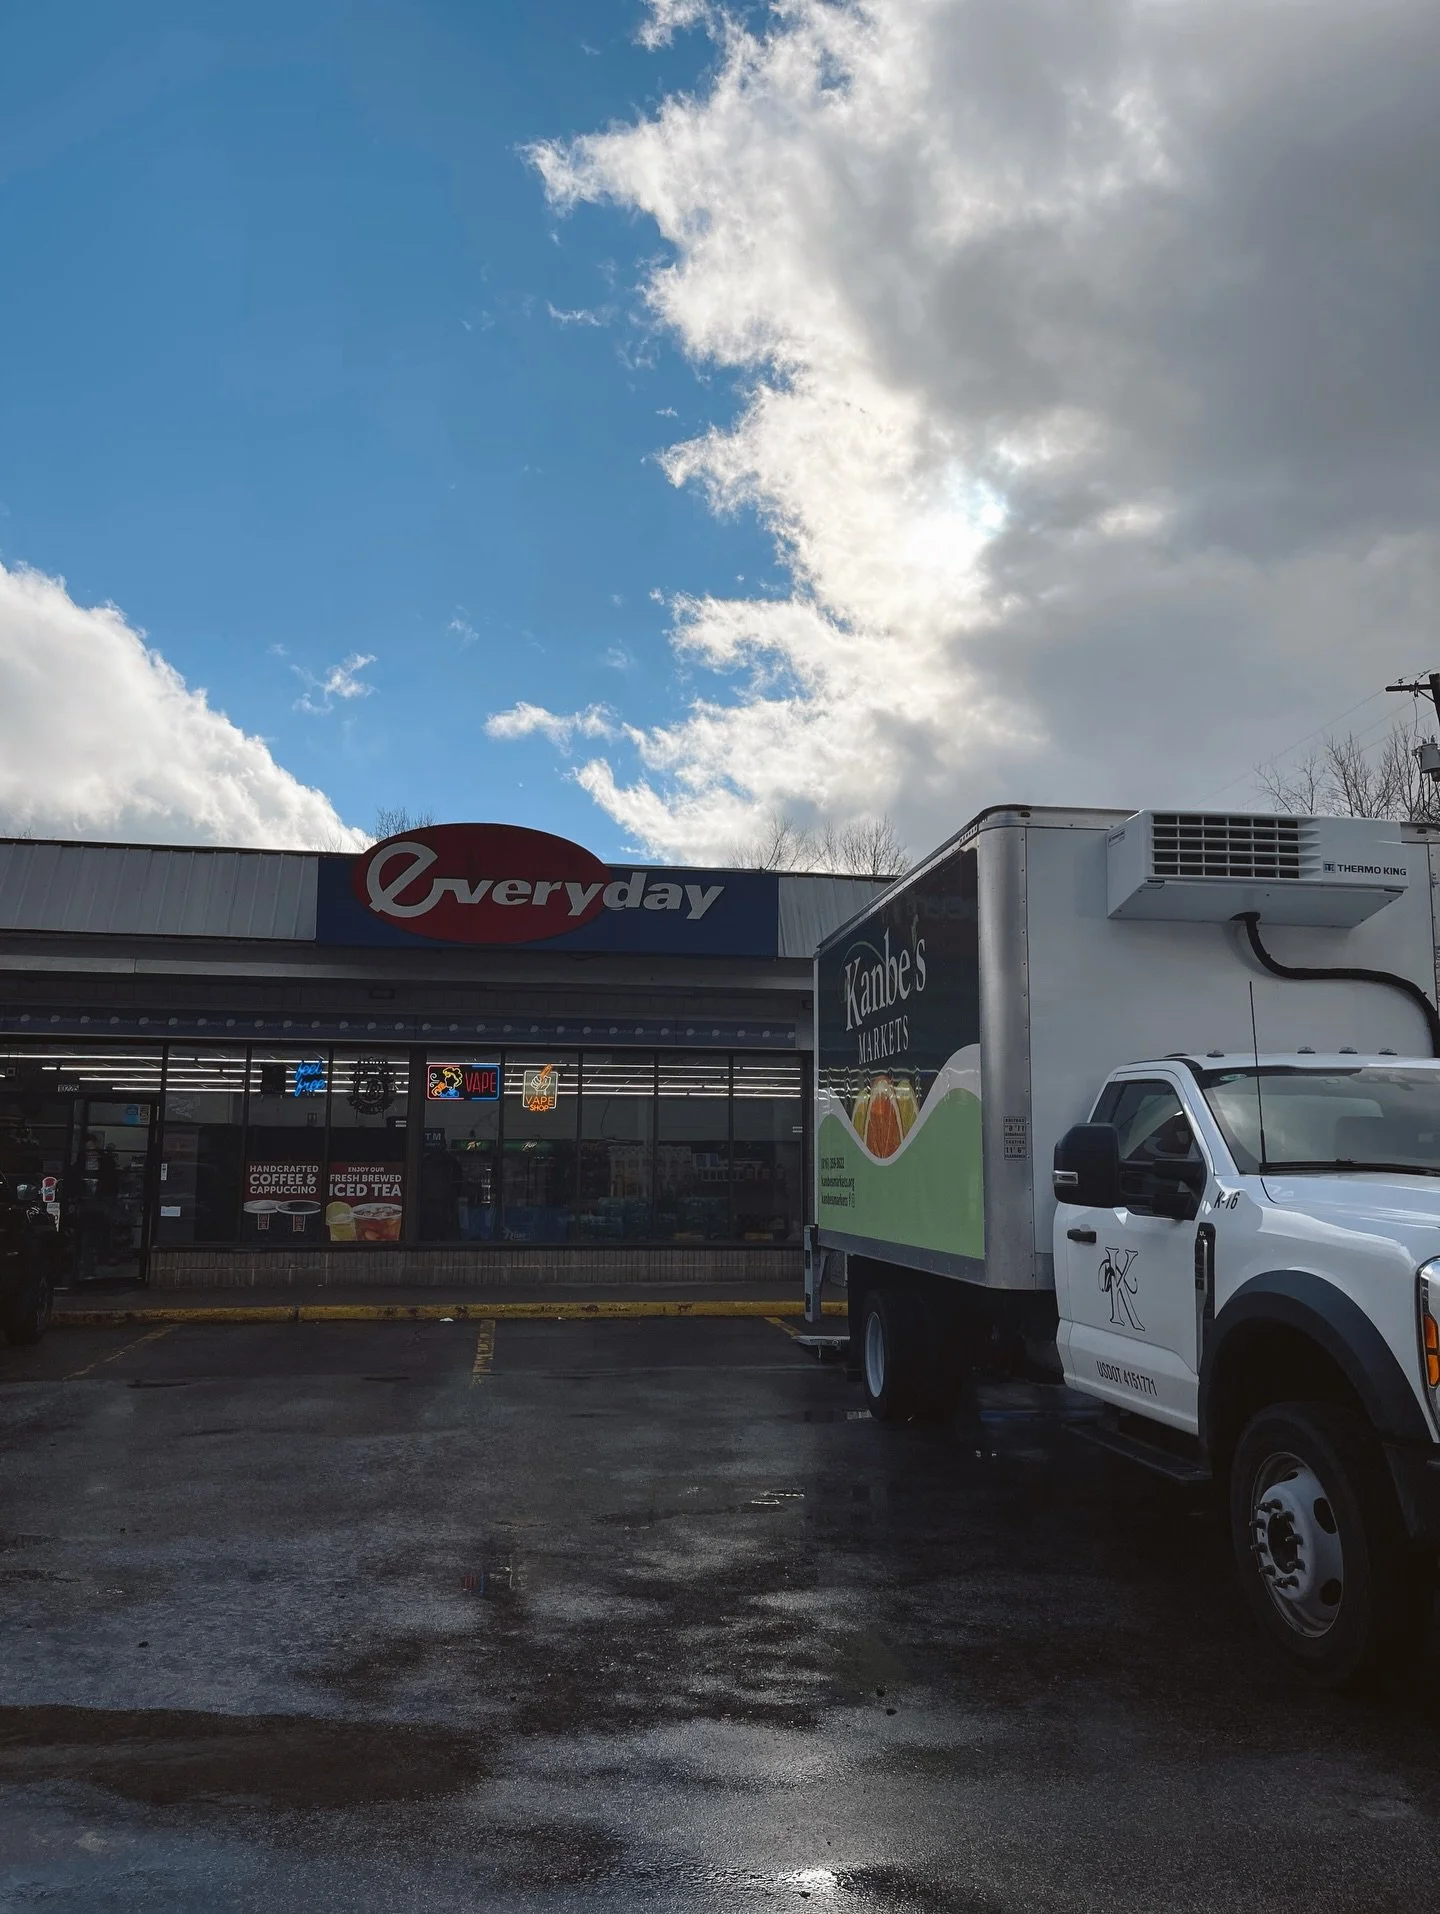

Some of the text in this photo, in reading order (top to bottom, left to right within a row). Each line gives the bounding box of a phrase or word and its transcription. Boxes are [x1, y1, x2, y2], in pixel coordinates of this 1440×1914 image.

[1337, 864, 1407, 876] THERMO KING
[366, 841, 726, 920] everyday
[845, 927, 927, 1032] Kanbe's
[858, 1015, 909, 1065] MARKETS
[294, 1059, 323, 1081] feel
[293, 1077, 326, 1098] free
[465, 1072, 497, 1093] VAPE
[525, 1096, 555, 1106] VAPE
[529, 1104, 550, 1112] SHOP
[249, 1165, 319, 1173] HANDCRAFTED
[249, 1173, 317, 1185] COFFEE &
[329, 1174, 402, 1183] FRESH BREWED
[249, 1186, 317, 1194] CAPPUCCINO
[328, 1183, 402, 1197] ICED TEA
[1213, 1191, 1241, 1210] K-16
[1096, 1360, 1158, 1397] USDOT 4151771
